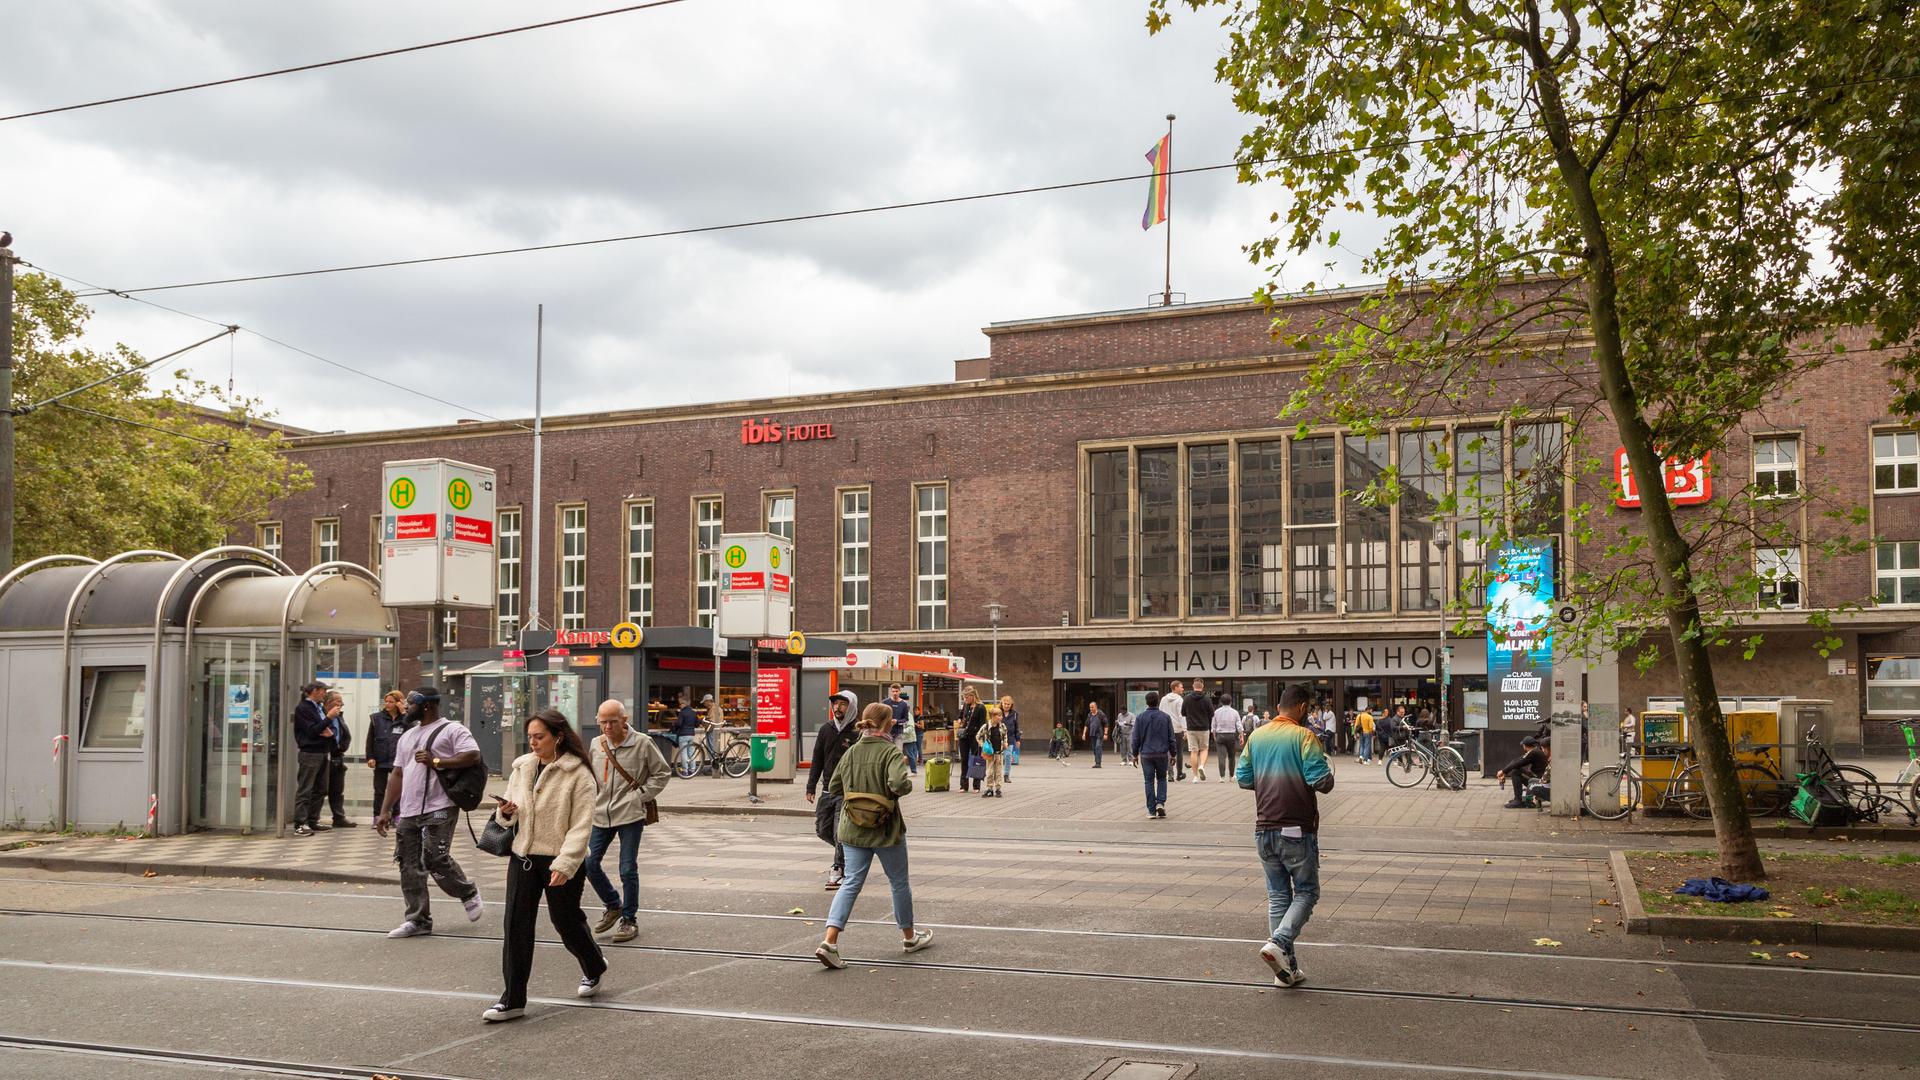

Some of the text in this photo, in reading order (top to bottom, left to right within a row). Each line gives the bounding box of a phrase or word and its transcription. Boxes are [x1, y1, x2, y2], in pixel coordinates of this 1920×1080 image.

[741, 417, 836, 445] ibis HOTEL
[387, 522, 394, 534] 6
[397, 527, 431, 535] Hauptbahnhof
[446, 521, 452, 533] 6
[455, 528, 487, 539] Hauptbahnhof
[723, 577, 730, 586] 5
[556, 628, 610, 648] Kamps
[1503, 679, 1540, 690] FINAL FIGHT
